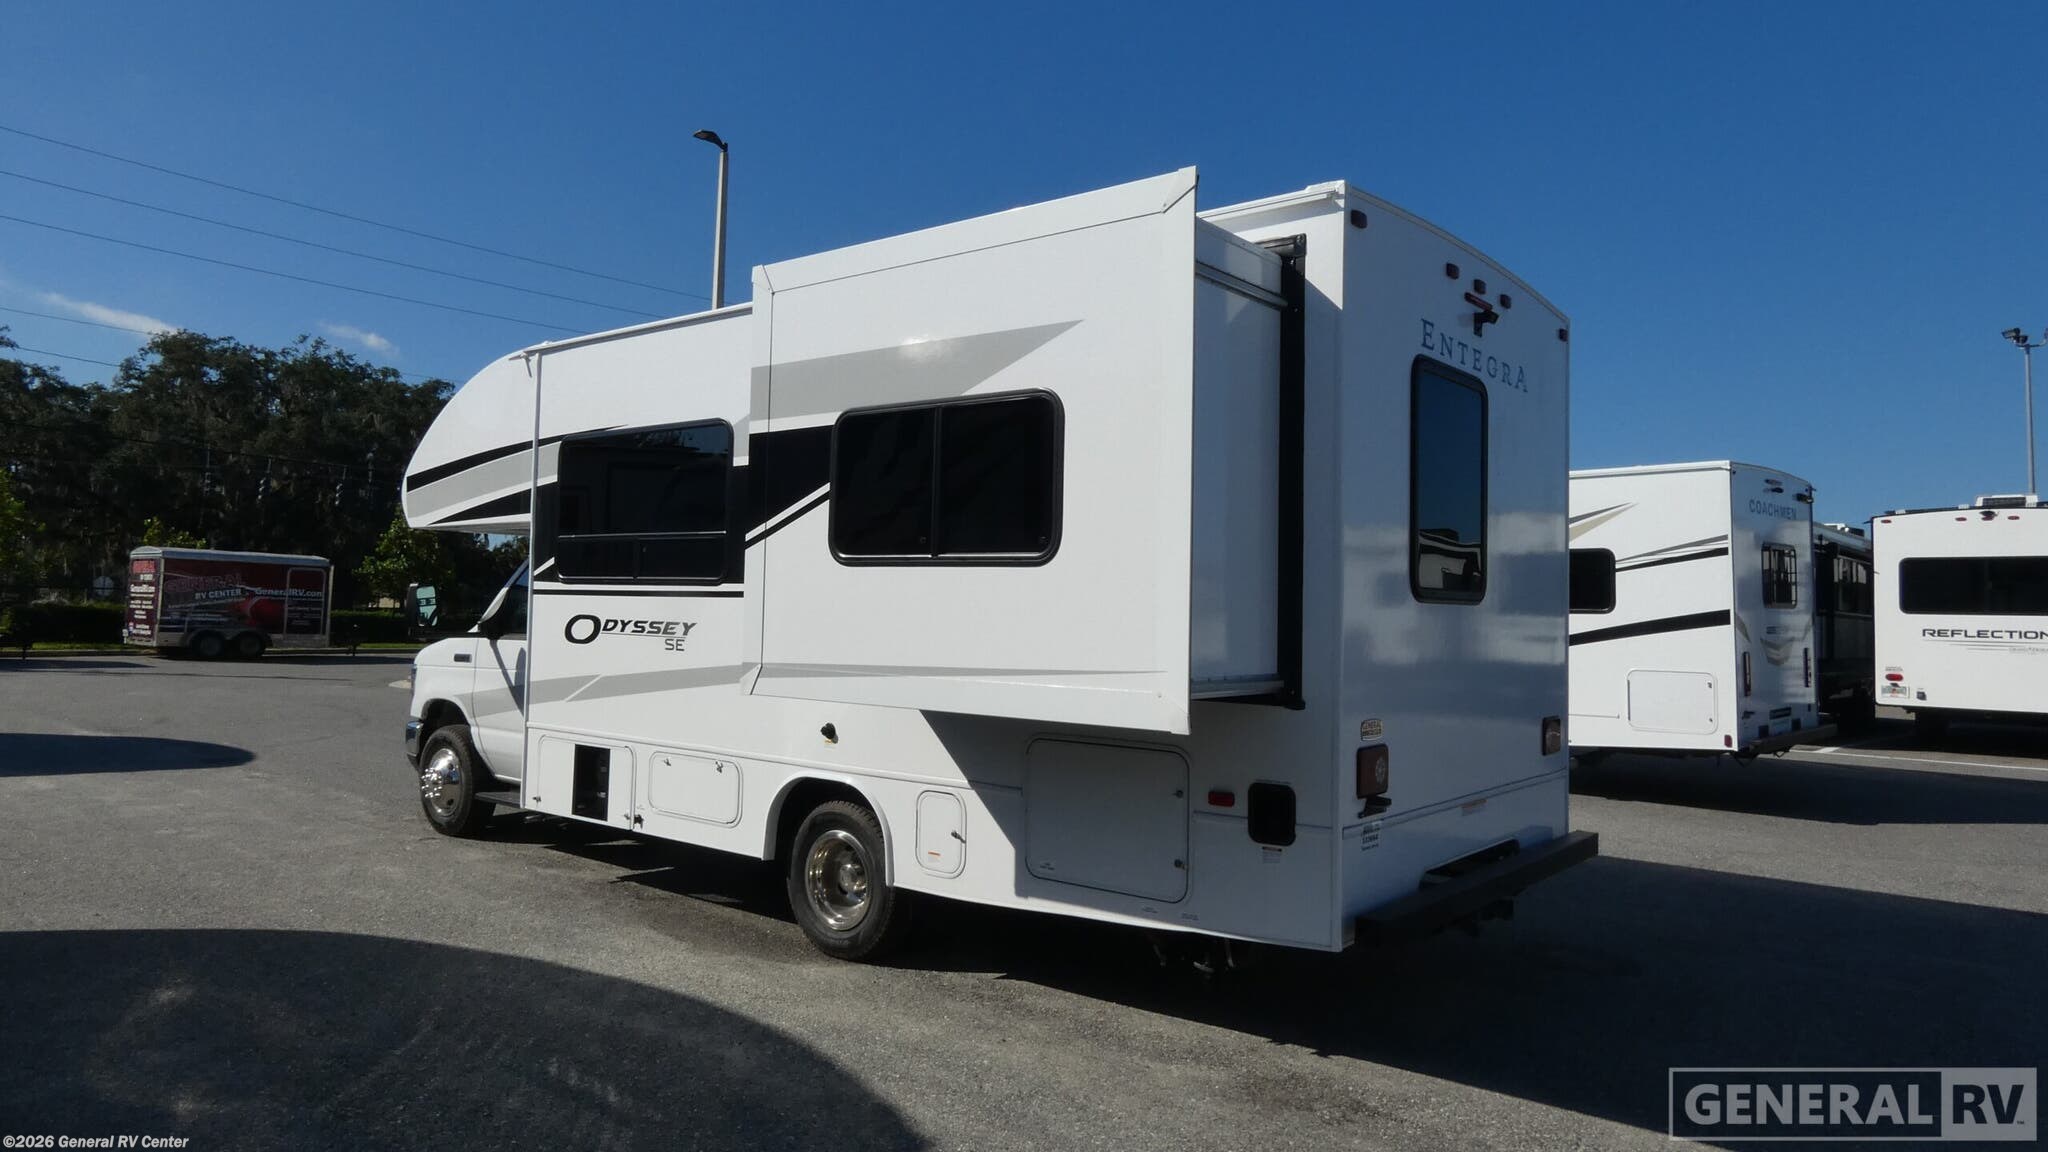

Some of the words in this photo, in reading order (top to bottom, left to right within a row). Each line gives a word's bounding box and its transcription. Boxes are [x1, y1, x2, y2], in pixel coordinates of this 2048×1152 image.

[1420, 318, 1529, 394] ENTEGRA
[1748, 499, 1797, 521] COACHMEN
[208, 588, 242, 600] CENTER
[565, 614, 698, 645] ODYSSEY
[665, 638, 685, 652] SE
